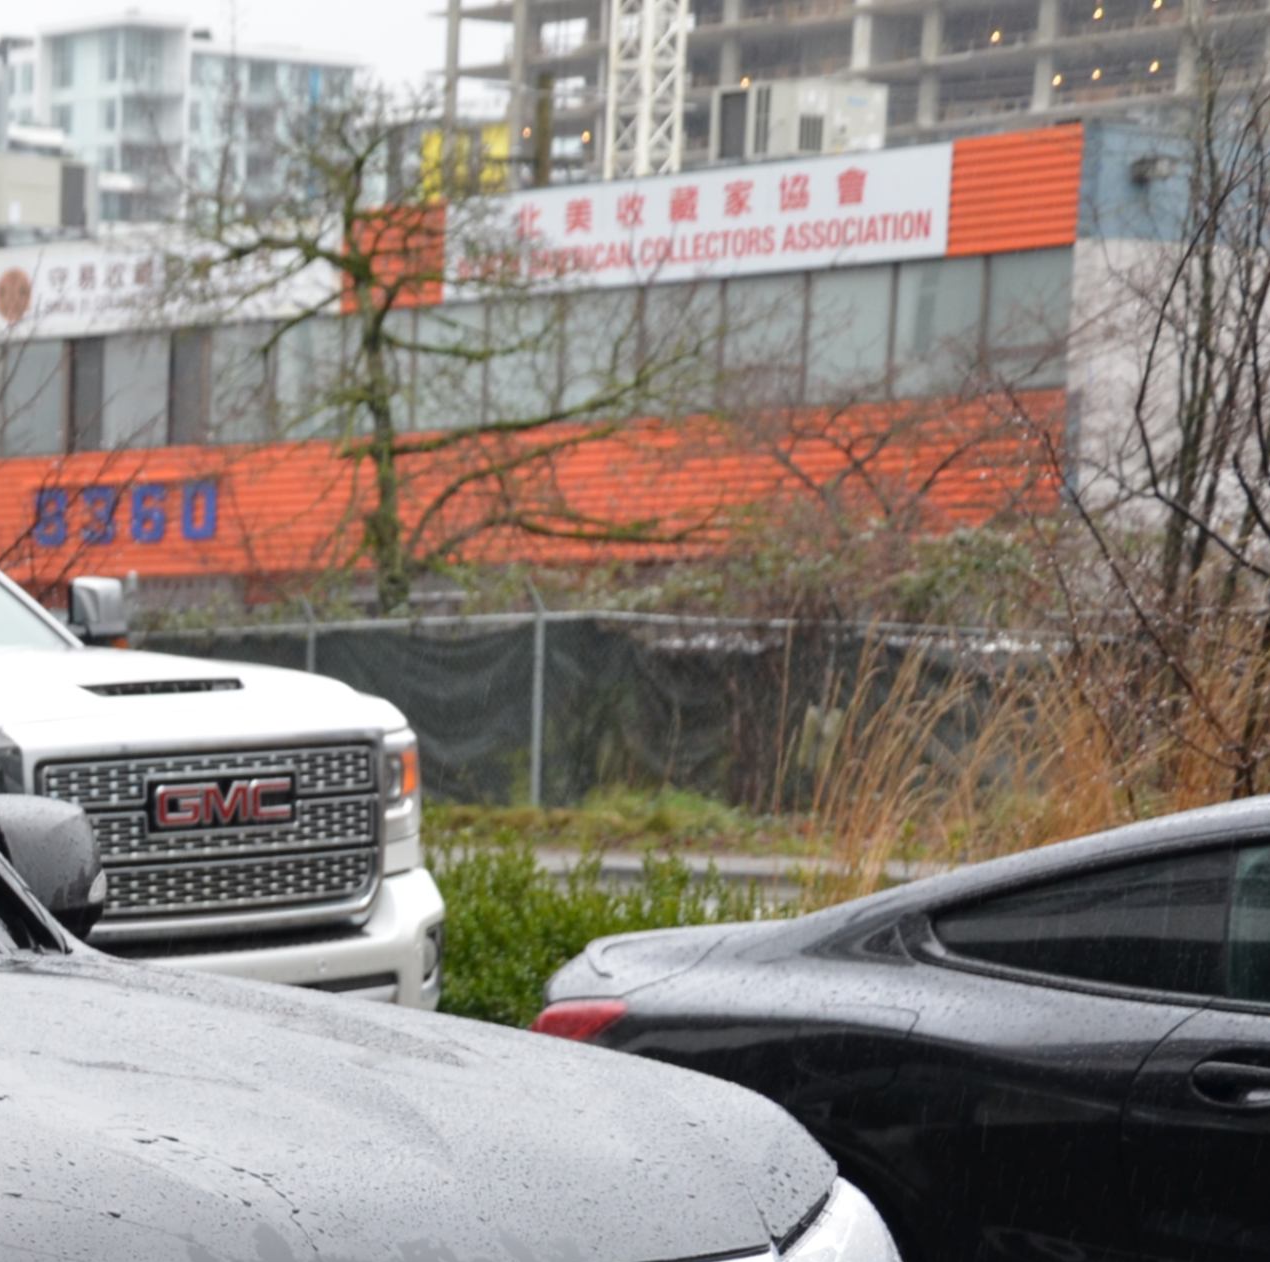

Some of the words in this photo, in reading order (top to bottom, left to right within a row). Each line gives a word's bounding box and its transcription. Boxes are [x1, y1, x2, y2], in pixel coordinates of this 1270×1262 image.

[639, 224, 776, 269] COLLECTORS
[781, 207, 933, 253] ASSOCIATION
[32, 479, 218, 548] 8360
[154, 776, 293, 828] GMC
